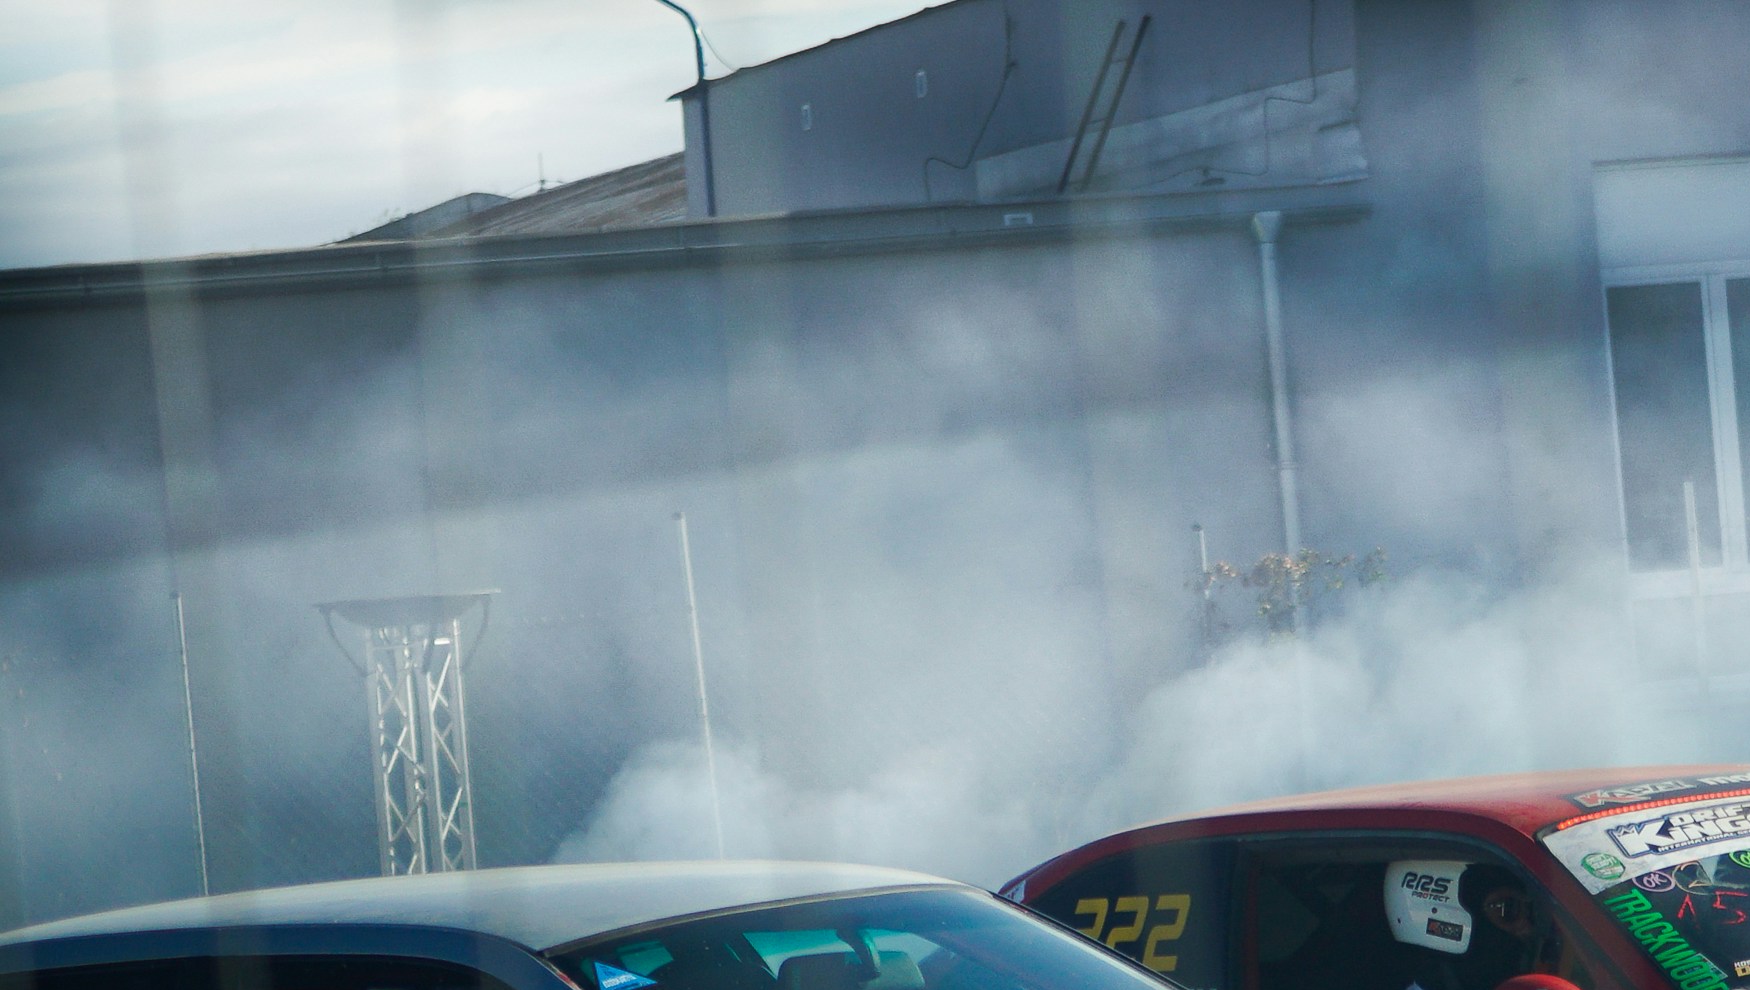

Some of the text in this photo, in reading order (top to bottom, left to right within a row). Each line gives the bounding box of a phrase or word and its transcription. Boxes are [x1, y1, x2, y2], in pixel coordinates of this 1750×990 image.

[1658, 832, 1734, 852] INTERNATIONAL
[1401, 871, 1453, 895] RRS
[1411, 890, 1450, 903] PROTECT
